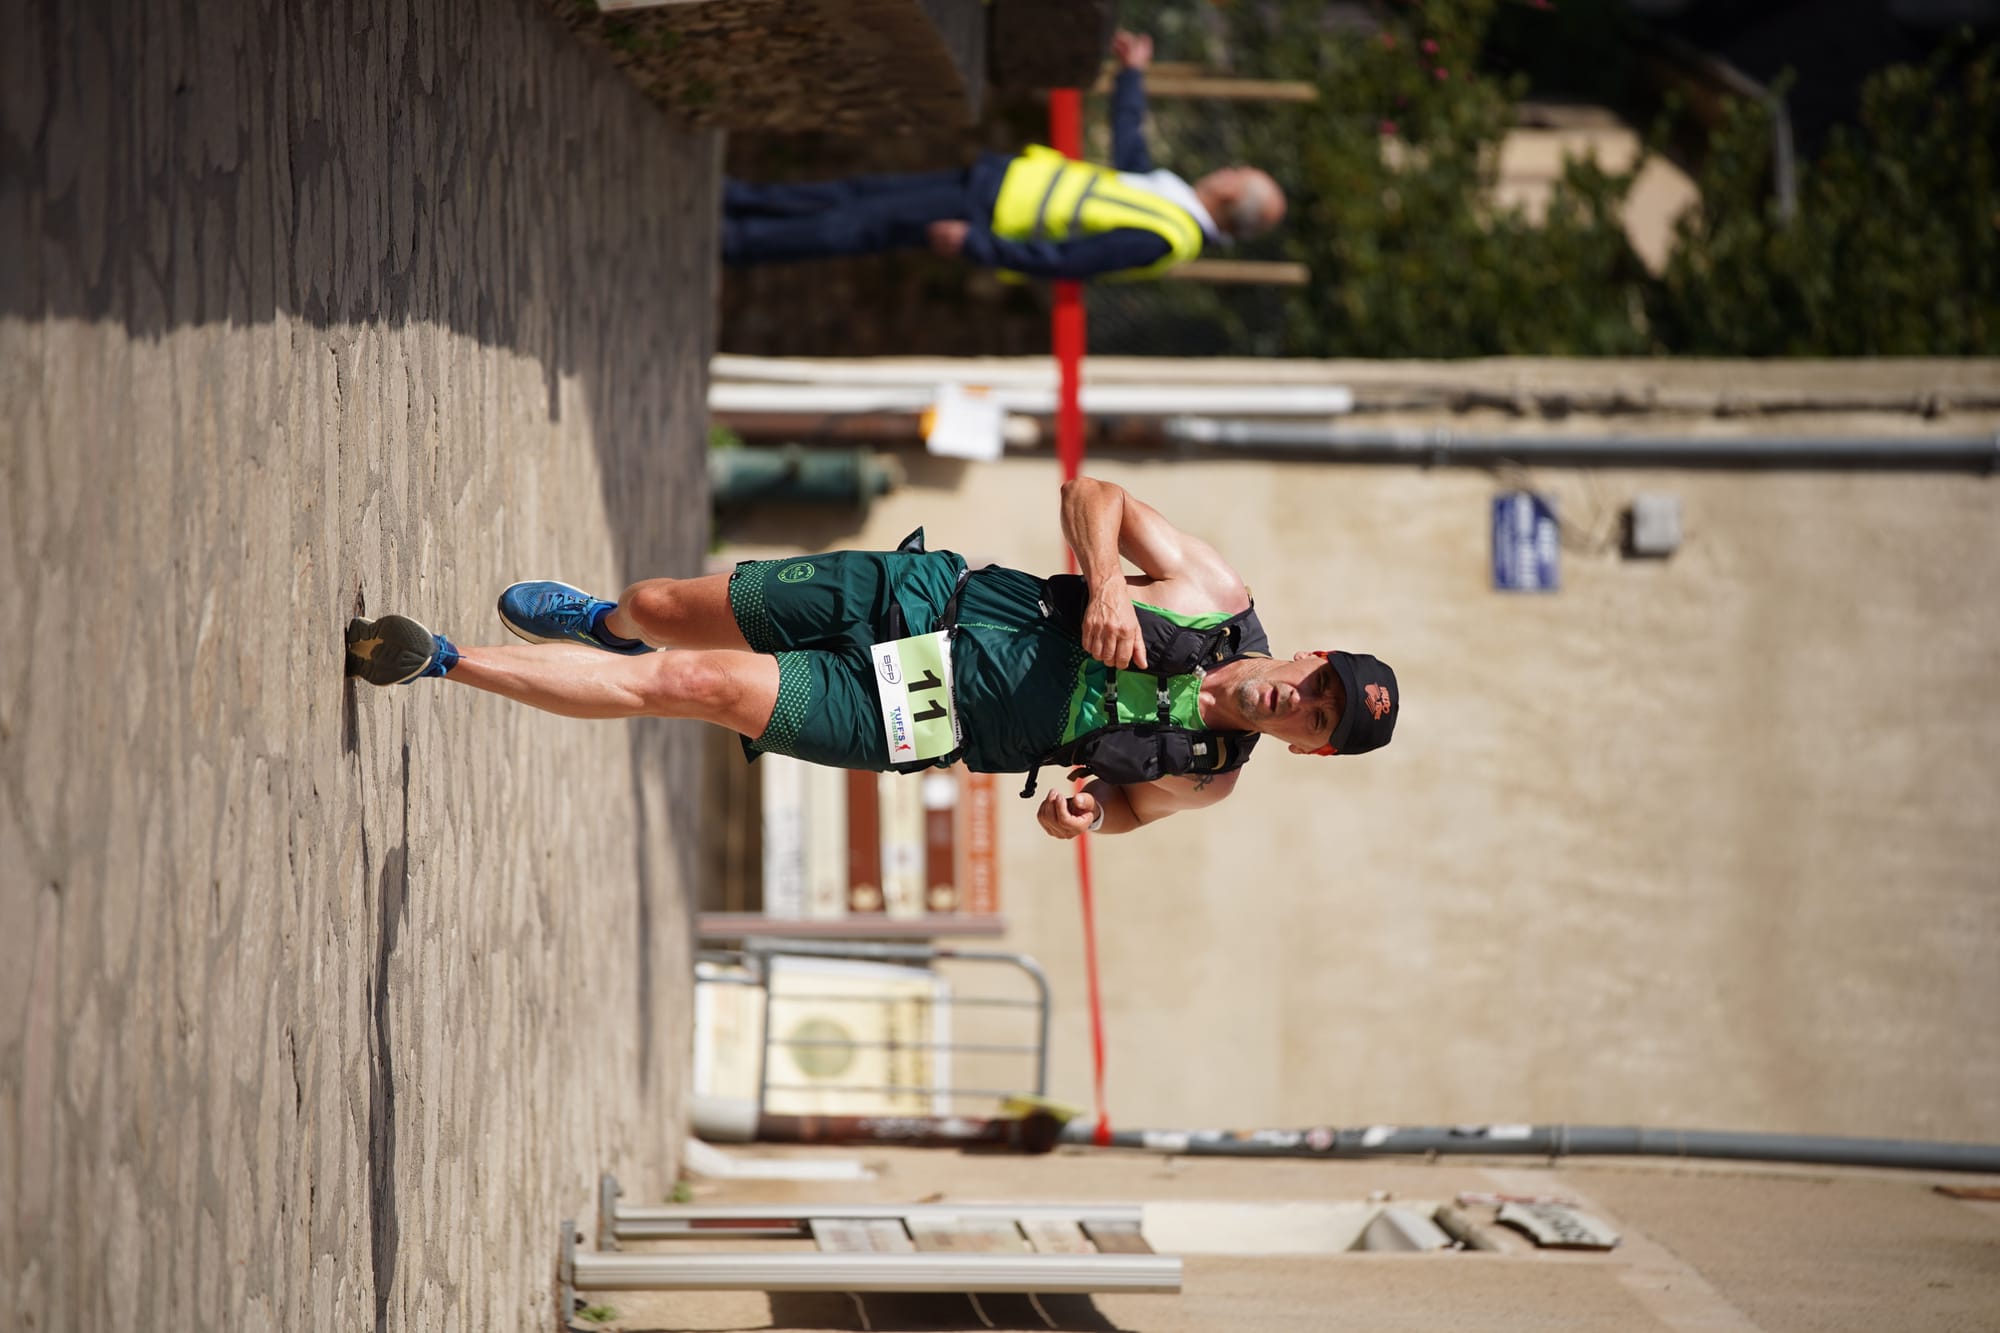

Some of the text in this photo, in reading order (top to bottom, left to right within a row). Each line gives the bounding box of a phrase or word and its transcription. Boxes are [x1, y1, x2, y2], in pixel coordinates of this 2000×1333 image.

[883, 654, 895, 681] BFP
[907, 669, 948, 723] 11
[893, 706, 906, 742] TUFF'S
